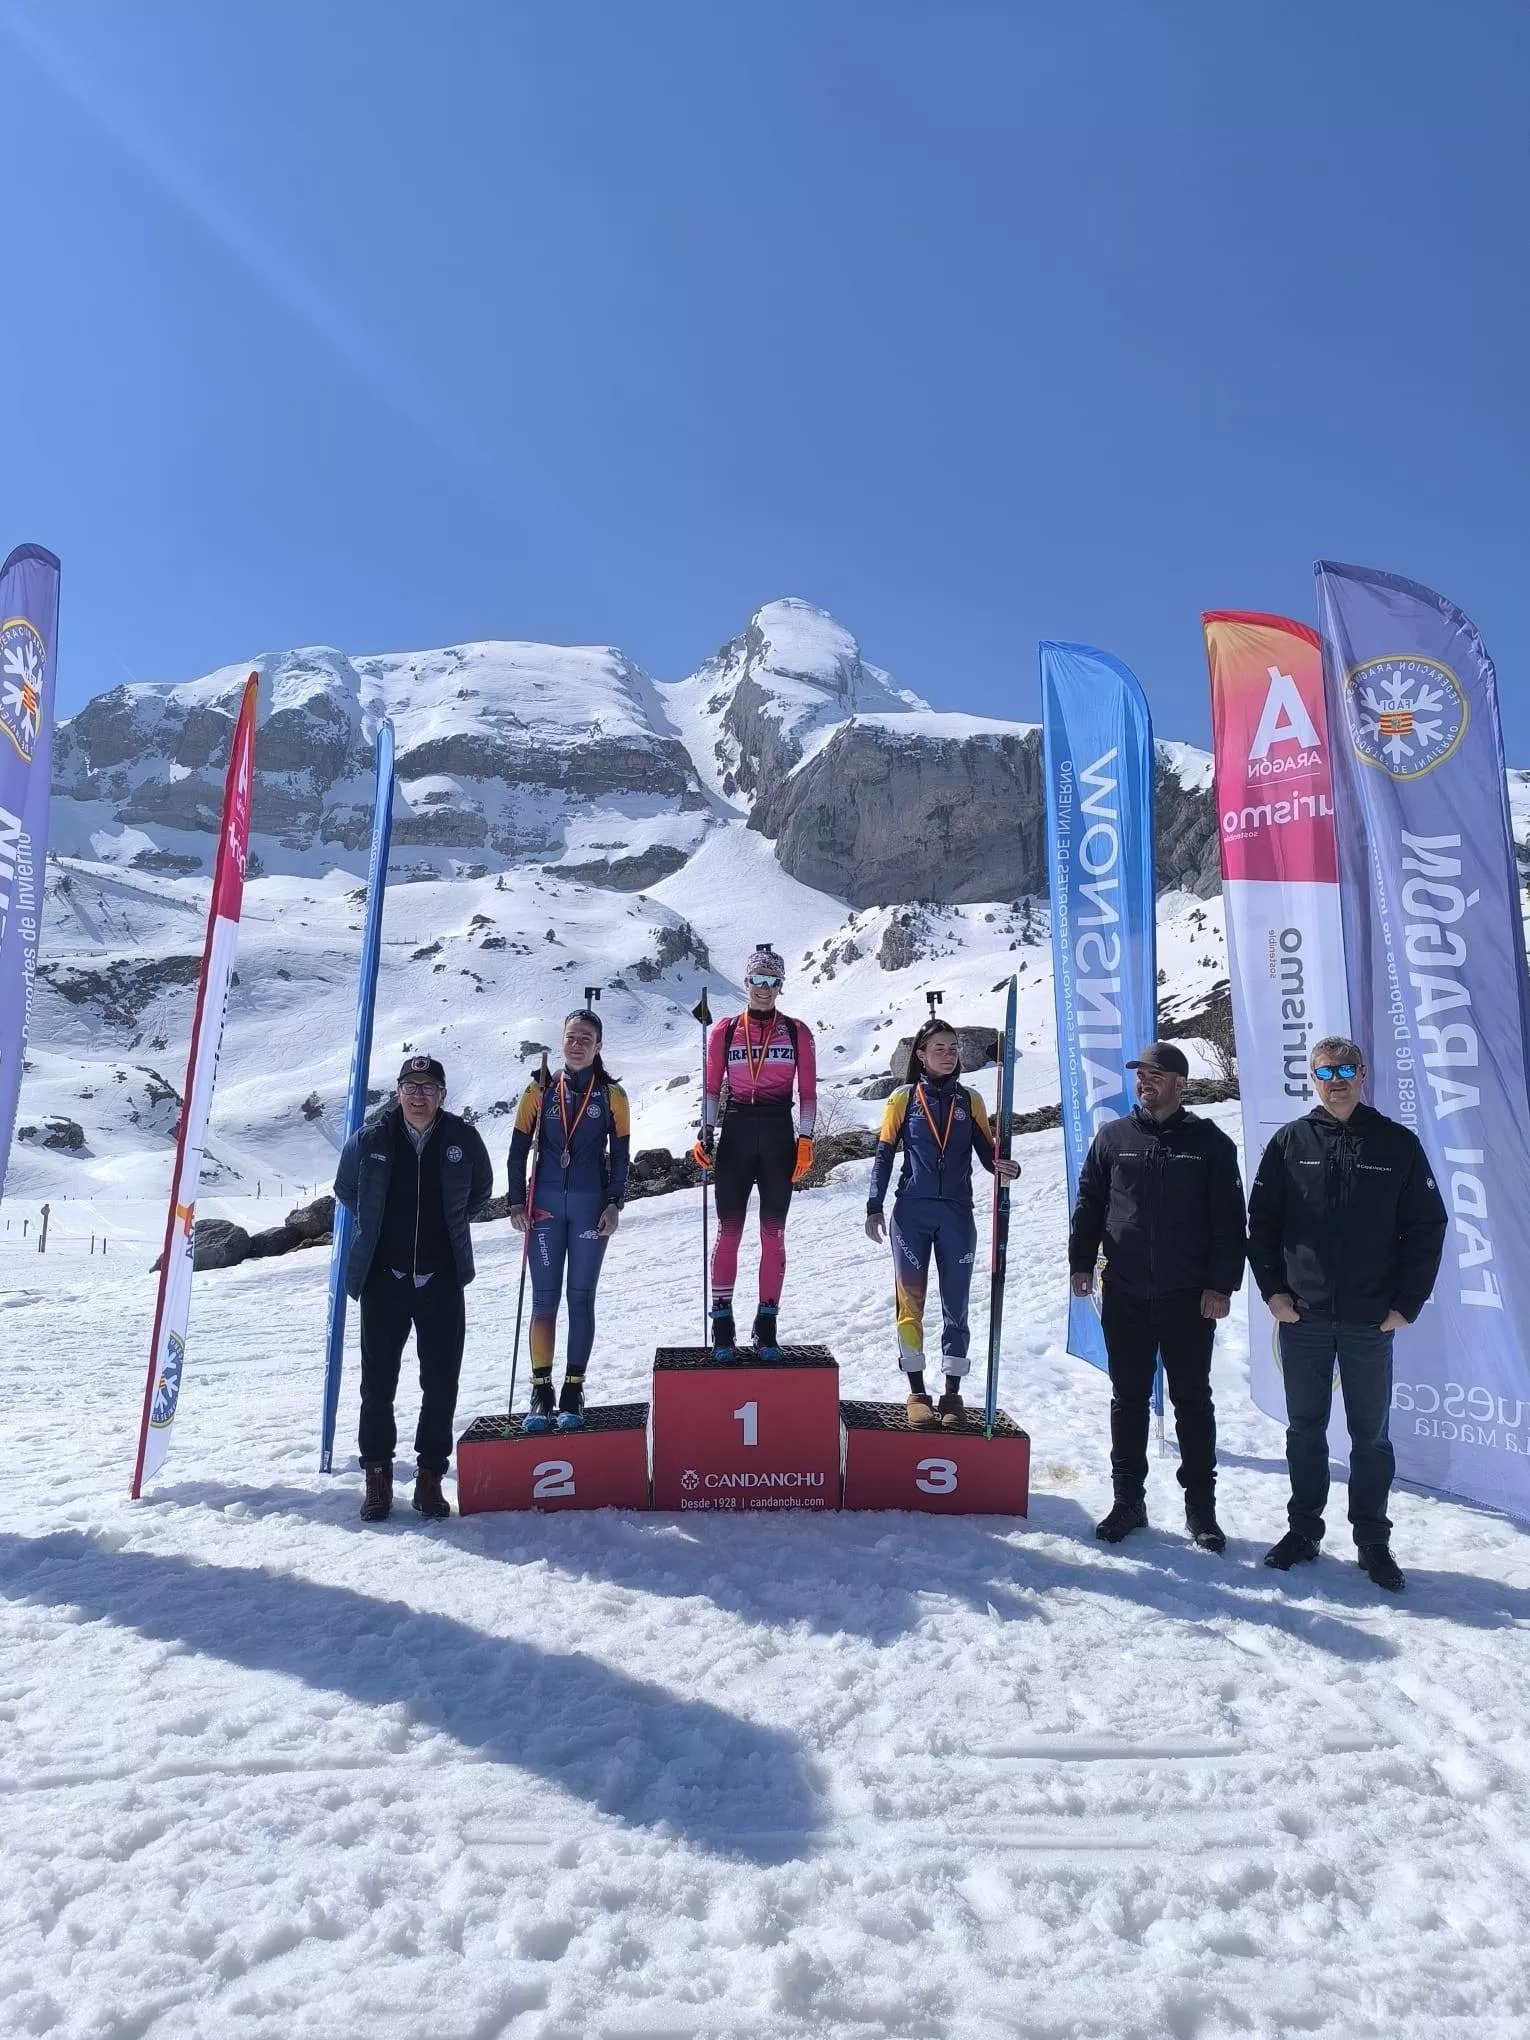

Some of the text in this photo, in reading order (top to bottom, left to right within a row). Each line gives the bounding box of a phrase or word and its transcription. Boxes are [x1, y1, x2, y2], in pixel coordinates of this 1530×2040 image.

[13, 831, 35, 911] Invierno
[17, 916, 37, 942] de
[538, 1232, 551, 1266] turismo
[733, 1401, 758, 1446] 1
[532, 1460, 576, 1498] 2
[704, 1472, 825, 1488] CANDANCHU
[915, 1458, 958, 1495] 3
[681, 1496, 825, 1509] Desde 1928 candanchu.com
